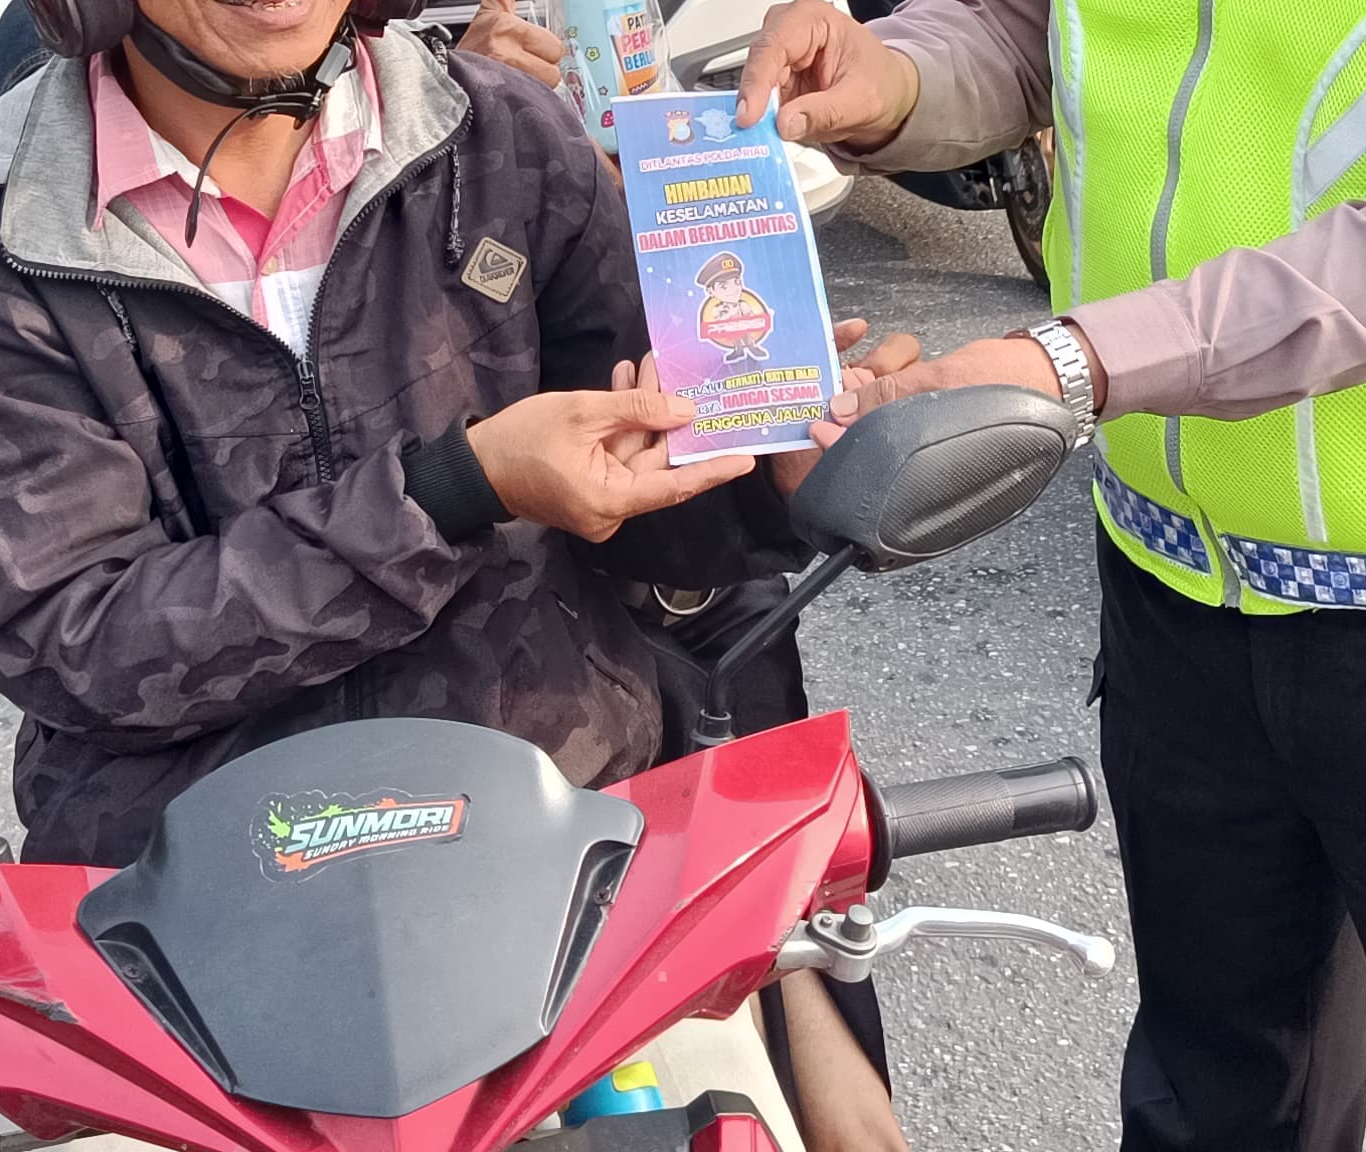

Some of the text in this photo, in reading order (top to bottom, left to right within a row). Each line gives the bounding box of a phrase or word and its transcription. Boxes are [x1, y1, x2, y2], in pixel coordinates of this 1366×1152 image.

[741, 146, 769, 160] RIAU
[664, 174, 753, 204] HIMBAUAN
[656, 198, 768, 224] KESELAMATAN
[638, 214, 796, 251] DALAM BERLALU LINTAS
[722, 391, 769, 410] HARGAI
[771, 385, 820, 402] SESAMA
[694, 411, 772, 435] PENGGUNA
[285, 806, 454, 853] SUNMORI
[303, 824, 450, 860] SUNDAY MORNING RIDE
